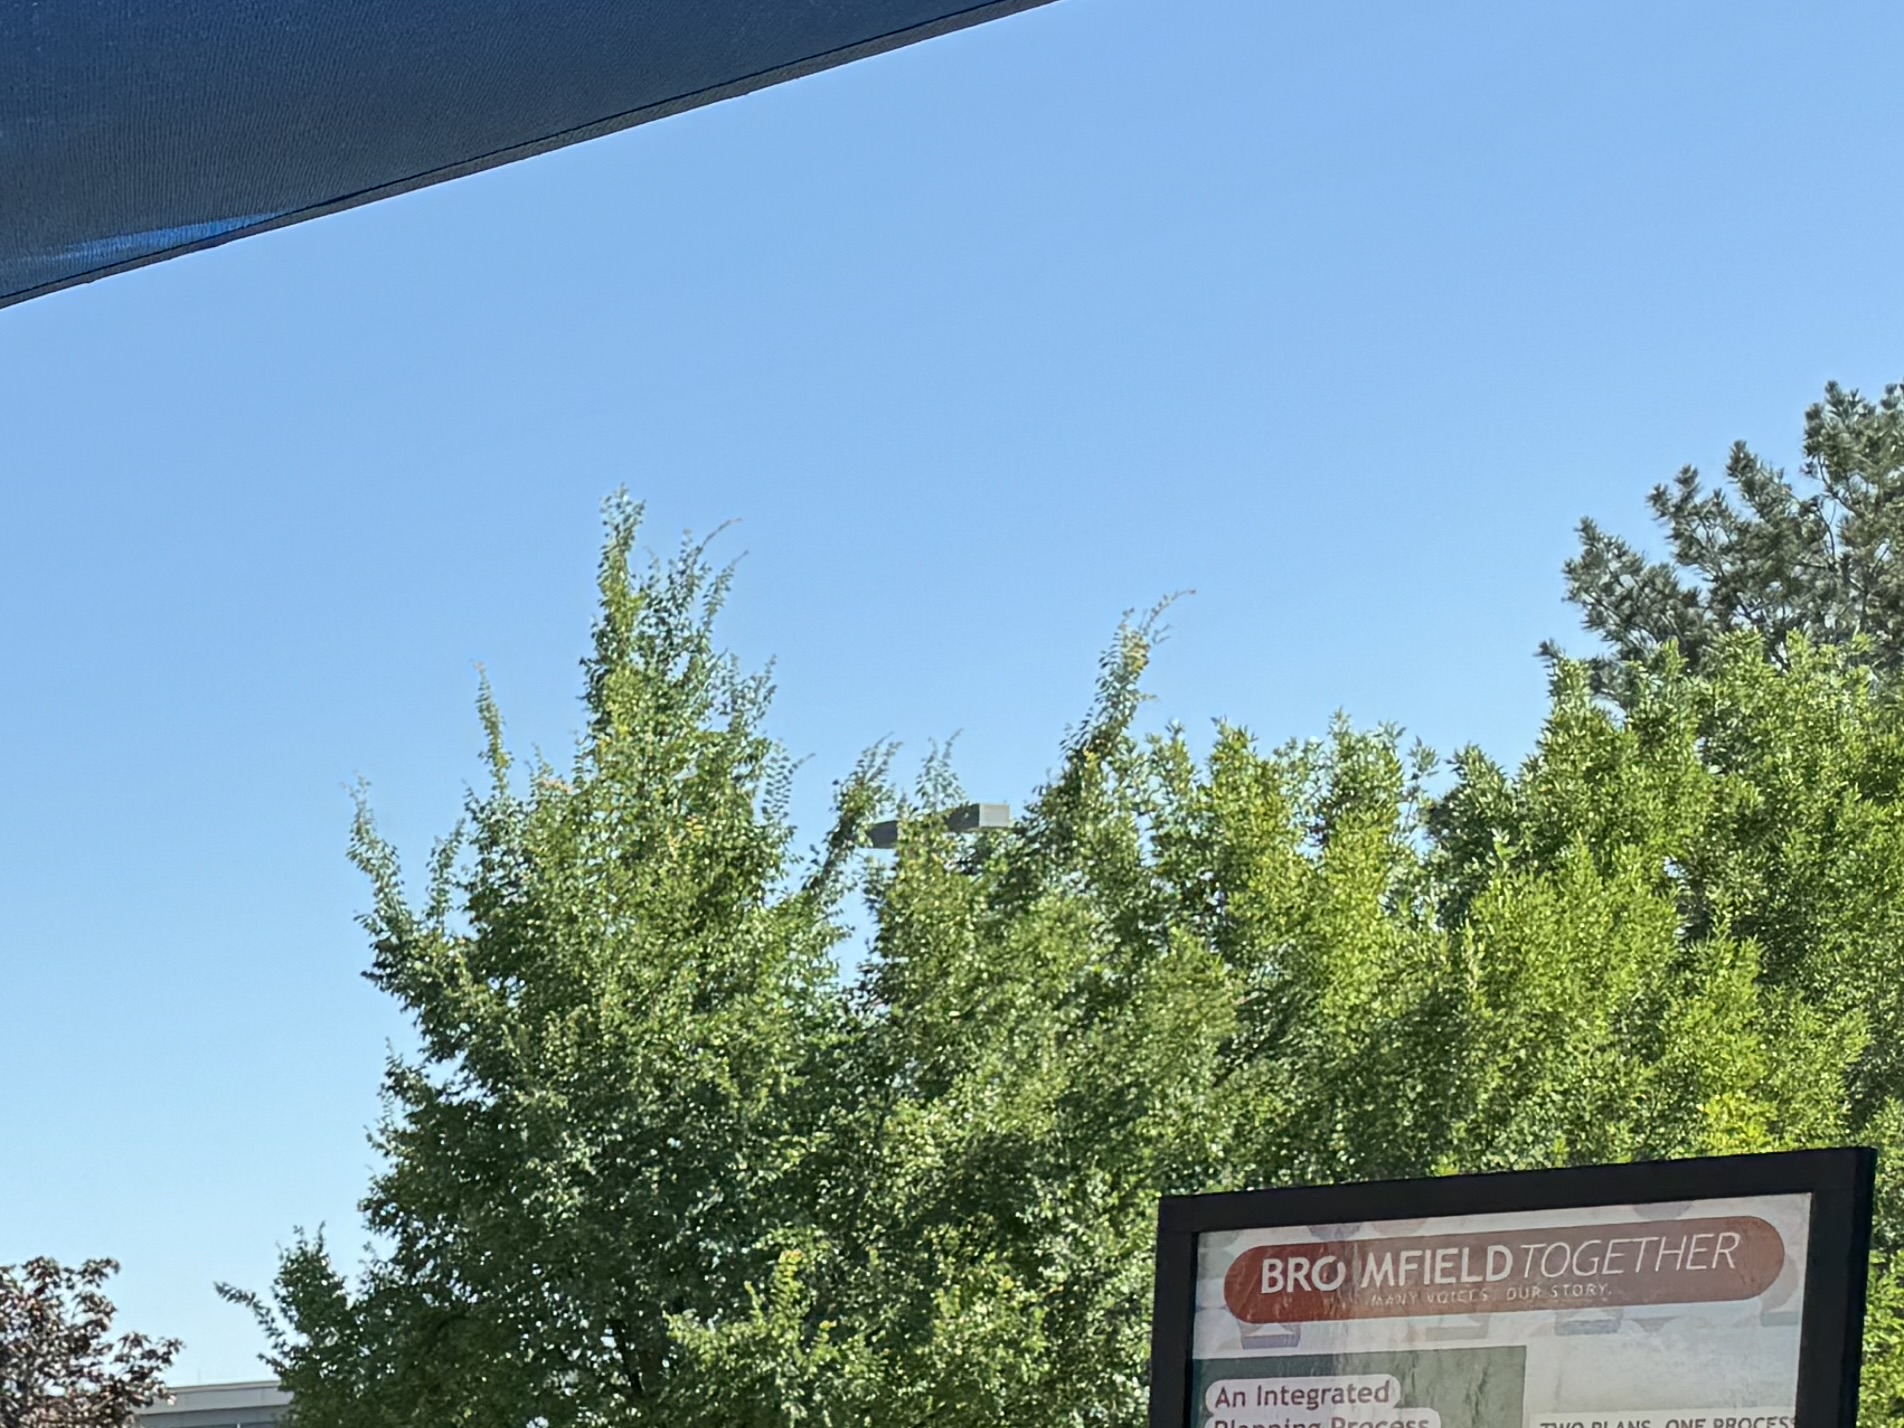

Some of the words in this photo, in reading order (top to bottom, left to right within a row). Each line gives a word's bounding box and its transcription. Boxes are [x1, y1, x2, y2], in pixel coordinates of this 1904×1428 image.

[1520, 1231, 1740, 1278] TOGETHER
[1506, 1286, 1540, 1301] OUR
[1214, 1386, 1245, 1407] An
[1256, 1379, 1389, 1410] Integrated
